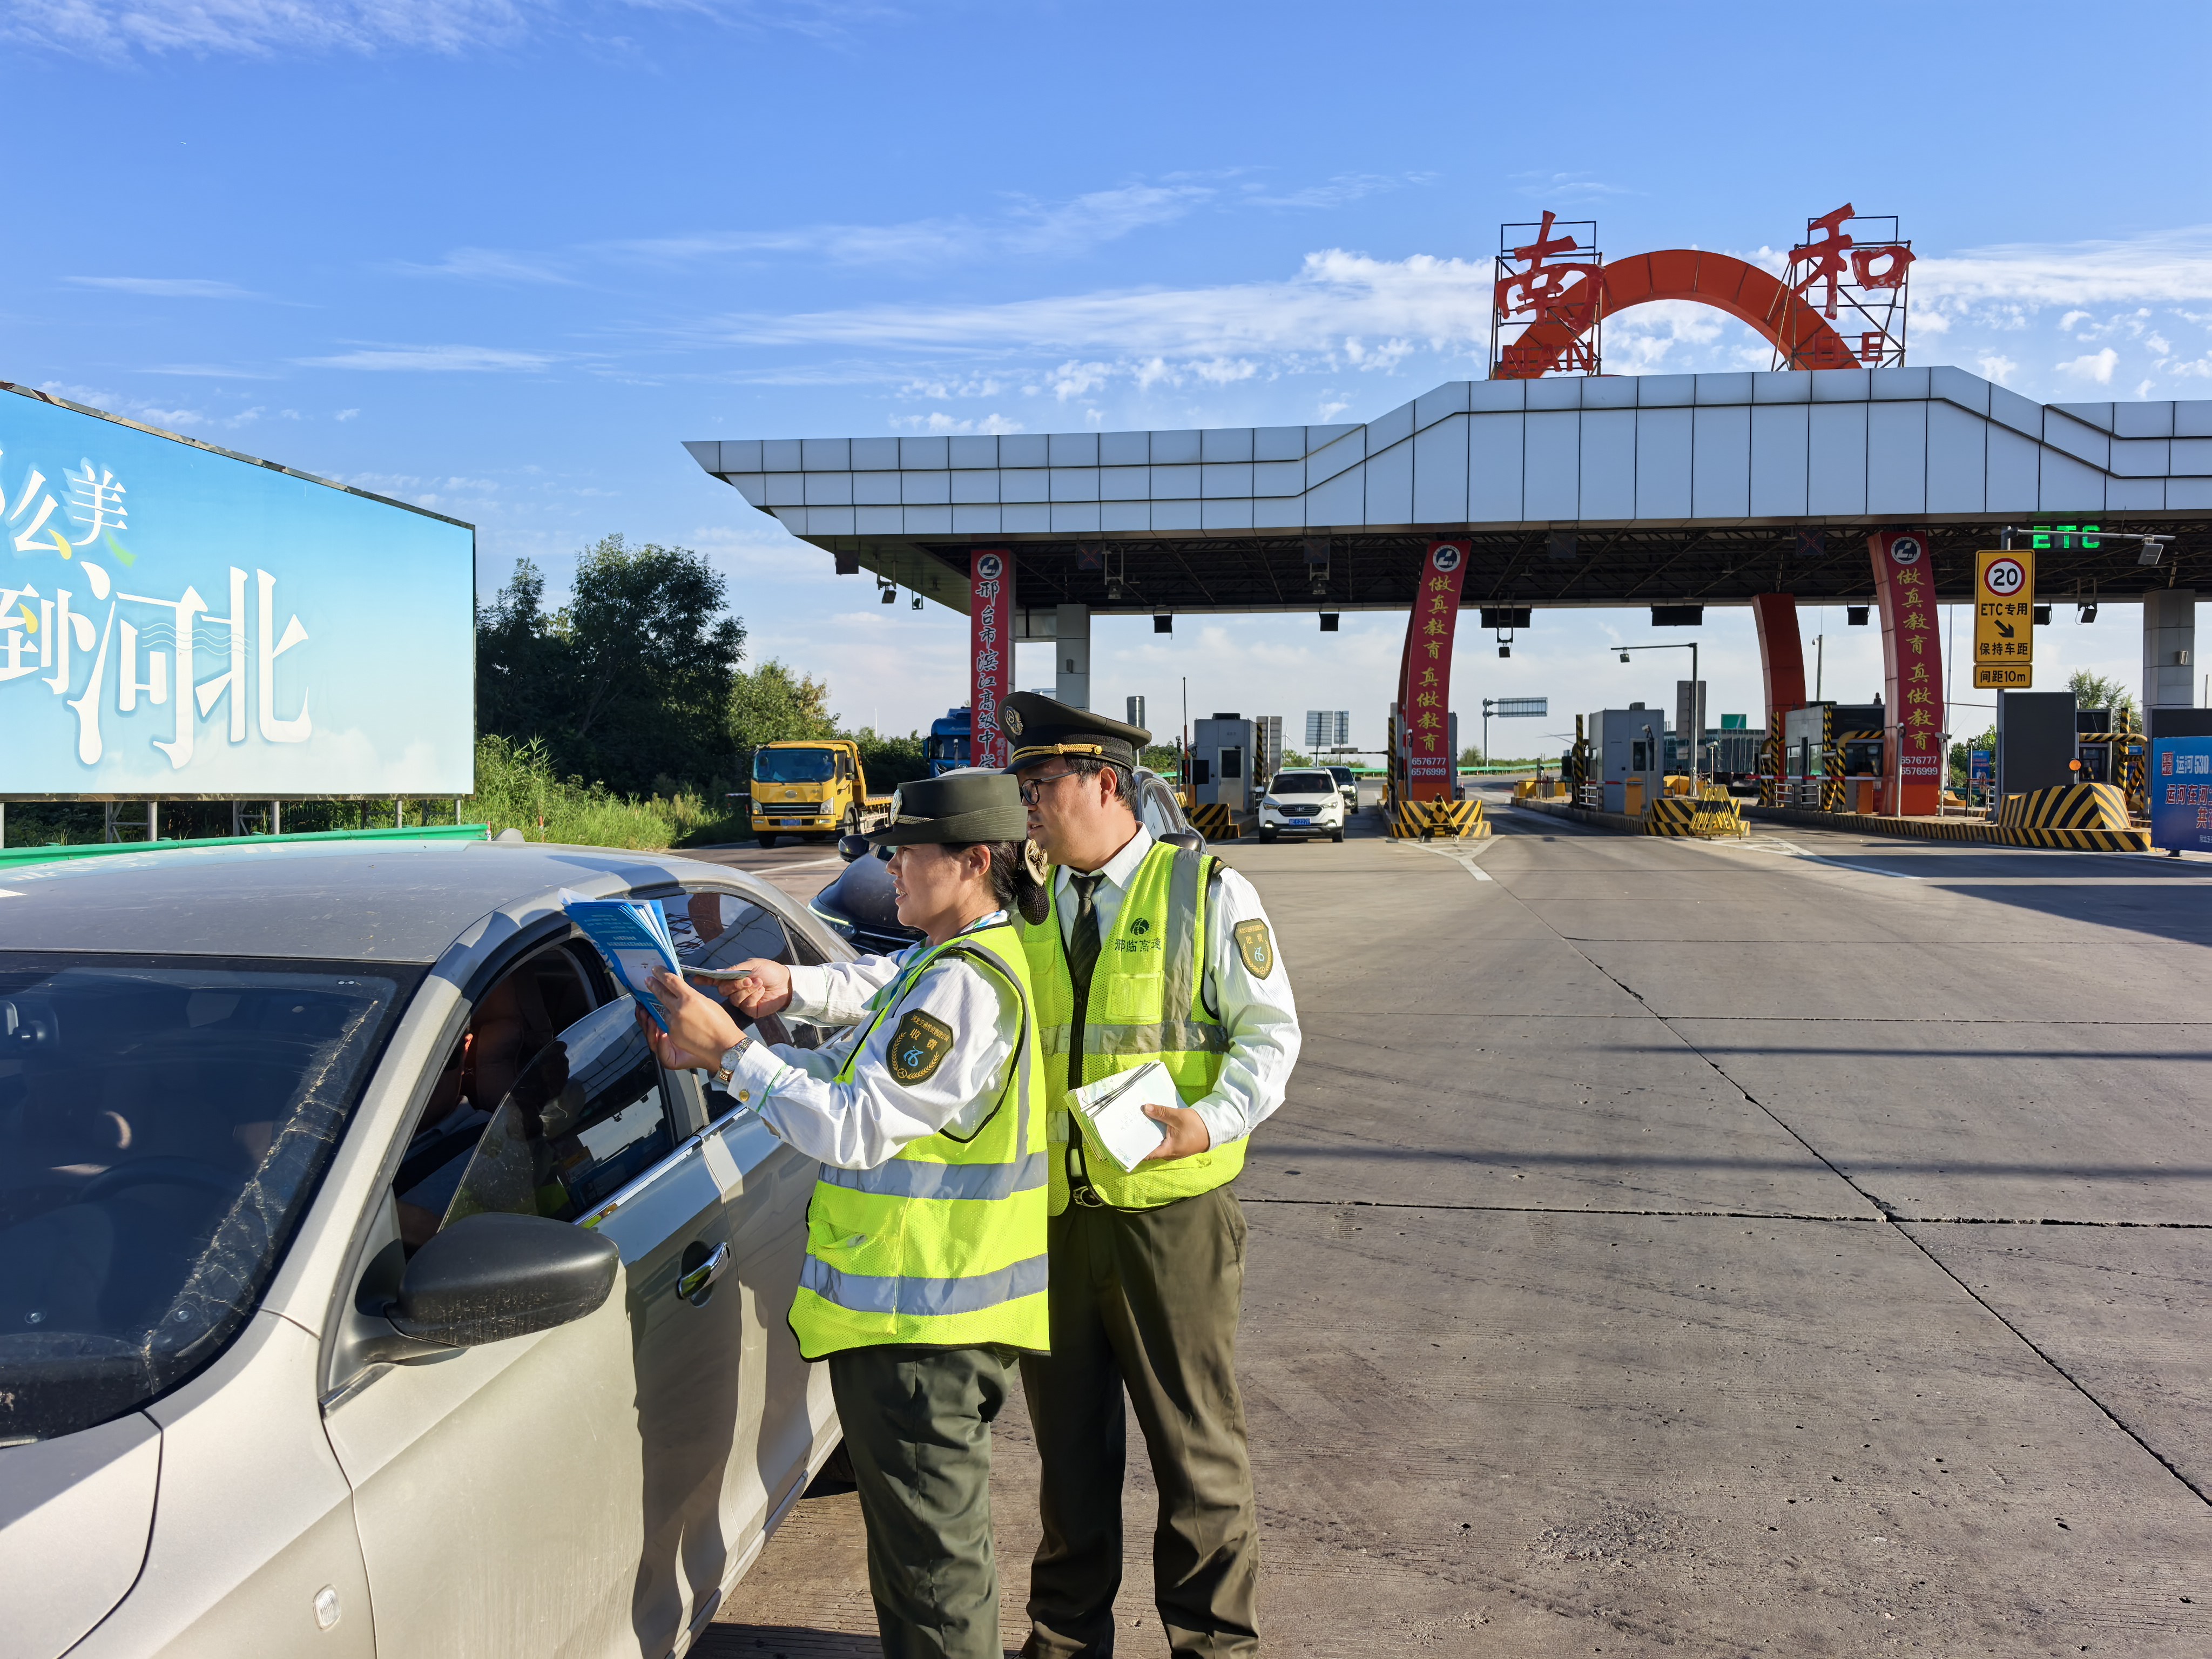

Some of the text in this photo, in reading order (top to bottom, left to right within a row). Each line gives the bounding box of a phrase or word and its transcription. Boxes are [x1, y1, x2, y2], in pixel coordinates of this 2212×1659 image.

[1495, 202, 1917, 333] 南 和
[1502, 331, 1883, 375] NAN HE
[0, 448, 137, 567] 么美
[2033, 525, 2100, 549] ETC
[1993, 568, 2019, 586] 20
[1980, 602, 2028, 616] ETC专用
[1979, 642, 2028, 656] 保持车距
[0, 561, 312, 769] 到河北
[1980, 670, 2026, 683] 间距10m
[1411, 757, 1446, 766] 6576777
[1901, 756, 1937, 764] 6576777
[2176, 755, 2212, 774] 运河530
[1411, 767, 1446, 776] 6576999
[1901, 767, 1938, 775] 6576999
[2165, 784, 2212, 806] 运河在河
[909, 1028, 938, 1050] 收费
